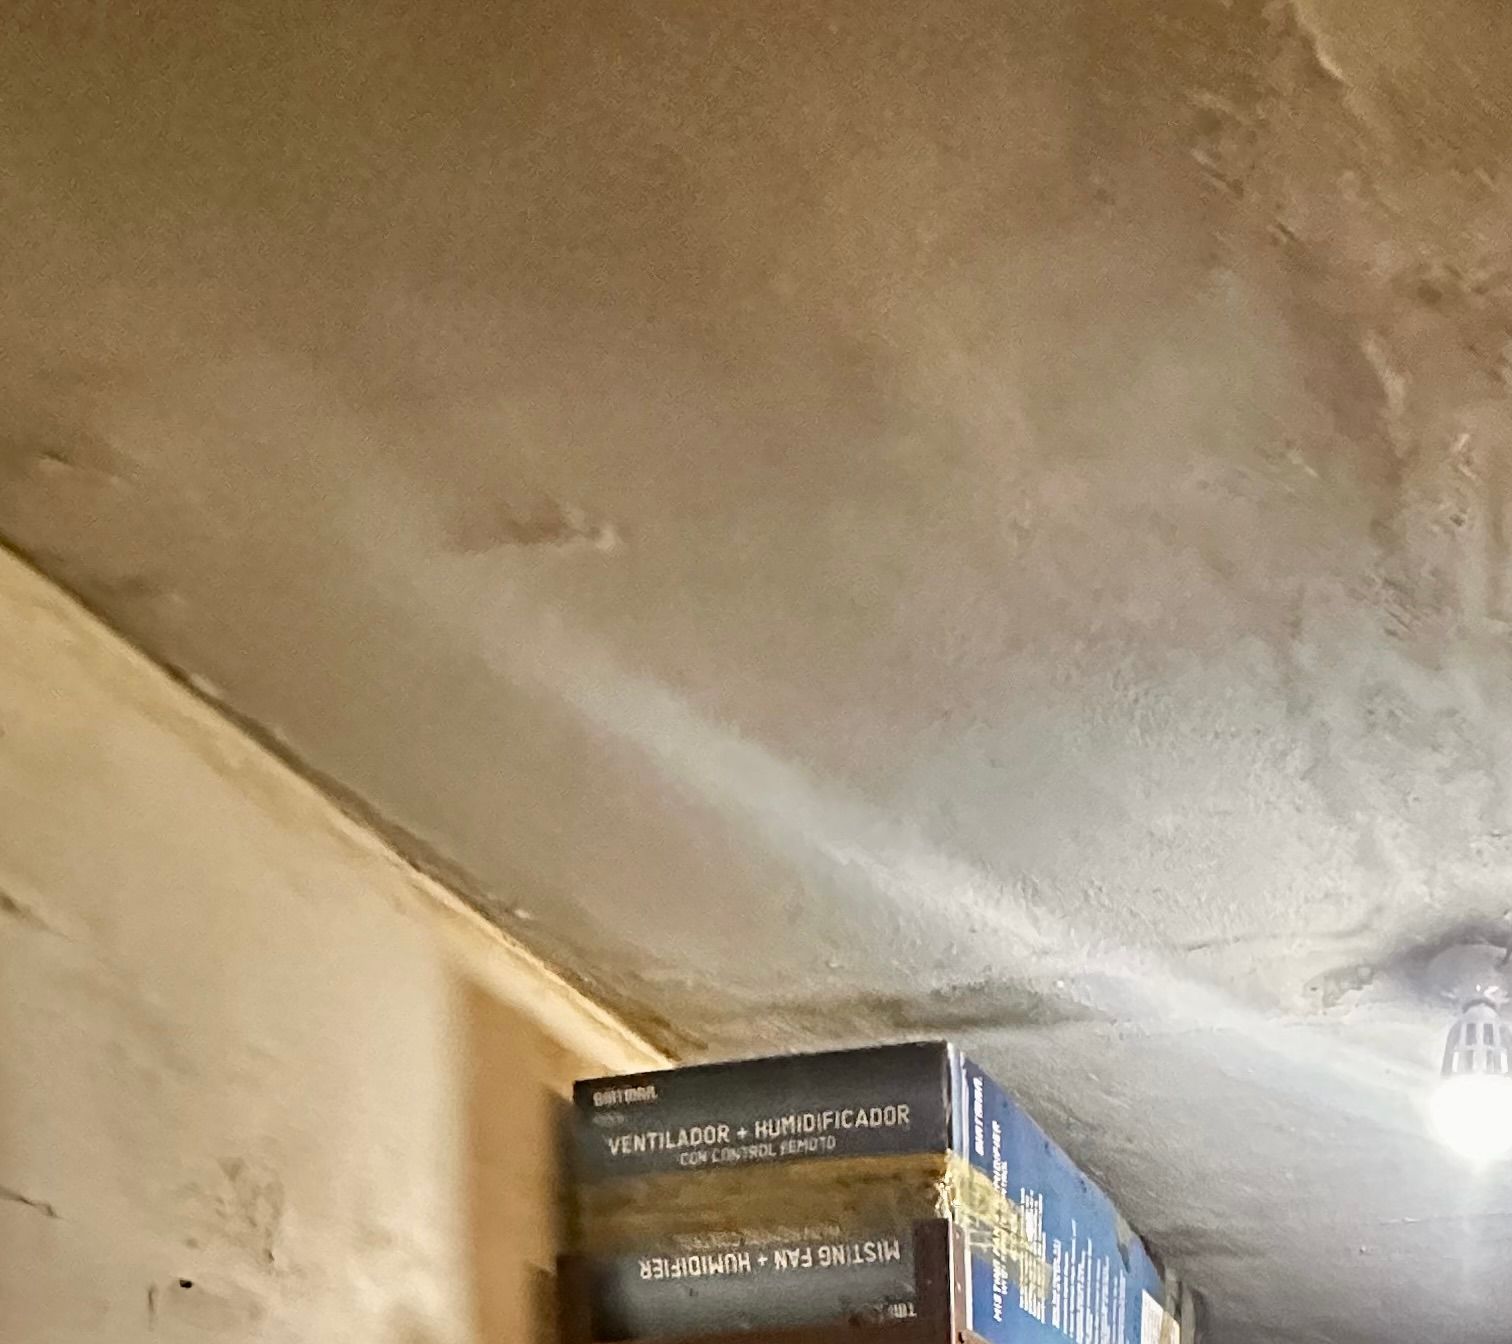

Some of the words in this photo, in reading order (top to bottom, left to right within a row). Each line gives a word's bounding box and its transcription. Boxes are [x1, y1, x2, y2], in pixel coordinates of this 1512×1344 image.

[608, 1125, 731, 1156] VENTILADOR
[755, 1104, 911, 1139] HUMIDIFICADOR
[680, 1149, 708, 1168] CON
[712, 1143, 777, 1165] CONTROL
[638, 1252, 752, 1280] HUMIDIFIER
[774, 1248, 813, 1271] FAN
[818, 1239, 901, 1266] MISTING
